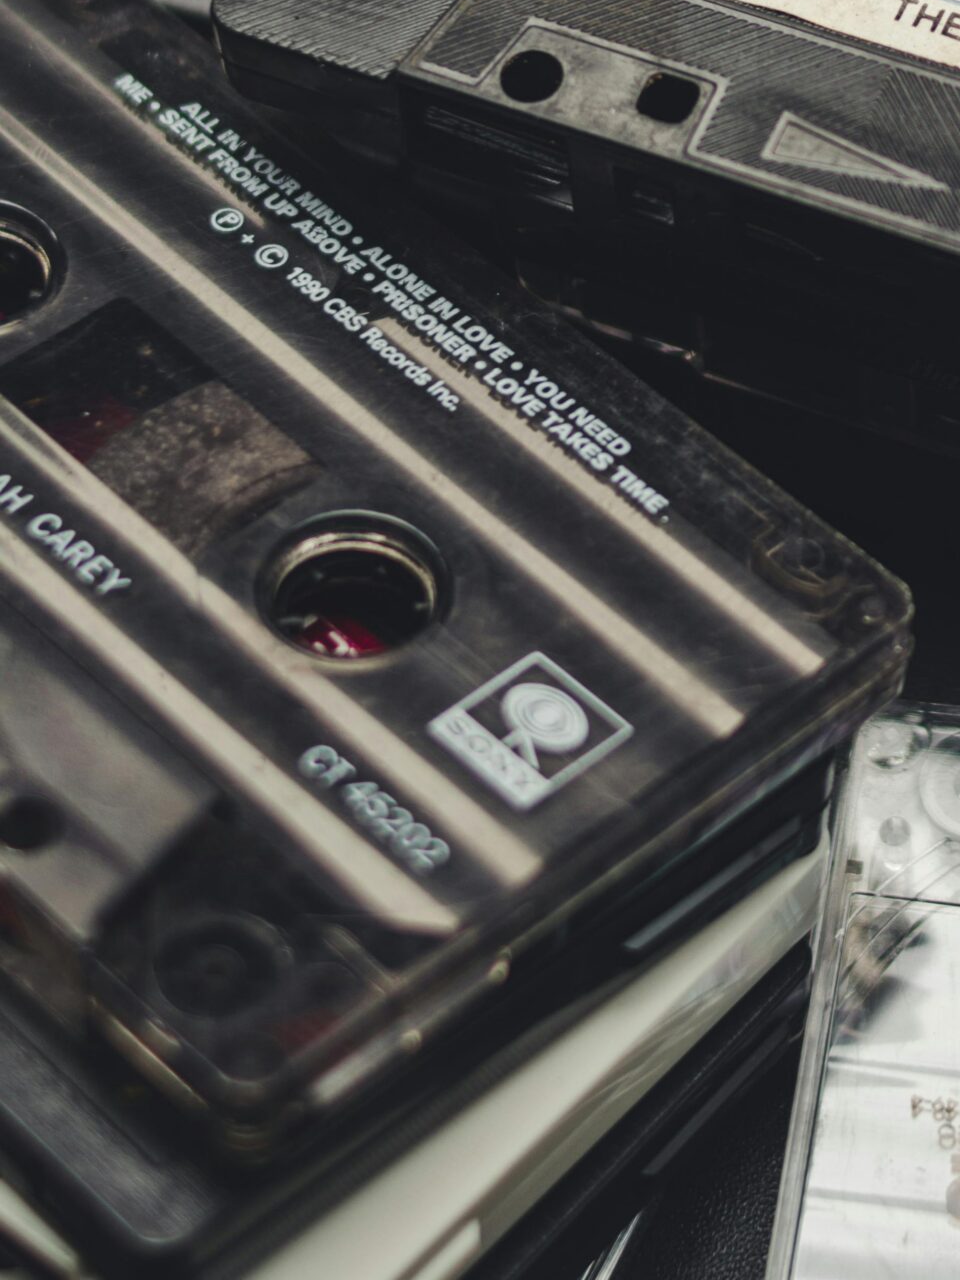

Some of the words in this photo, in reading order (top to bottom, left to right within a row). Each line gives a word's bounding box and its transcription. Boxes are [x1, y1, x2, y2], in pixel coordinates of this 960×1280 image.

[114, 73, 154, 104] ME
[158, 109, 216, 152] SENT
[208, 148, 269, 197] FROM
[263, 193, 299, 218] UP
[291, 219, 367, 275] ABOVE
[372, 280, 478, 364] PRISONER
[483, 367, 547, 417] LOVE
[542, 412, 614, 471] TAKES
[180, 101, 220, 134] ALL
[216, 129, 247, 152] IN
[243, 147, 302, 196] YOUR
[294, 191, 353, 236] MIND
[360, 246, 437, 301] ALONE
[427, 296, 460, 321] IN
[452, 314, 514, 364] LOVE
[524, 369, 576, 411] YOU
[568, 407, 632, 456] NEED
[286, 267, 331, 303] 1990
[323, 298, 368, 332] CBS
[360, 327, 432, 386] Records
[427, 380, 461, 412] Inc.
[27, 513, 132, 595] CAREY
[299, 745, 357, 789] CT
[340, 782, 450, 873] 45202
[446, 716, 529, 790] SONY
